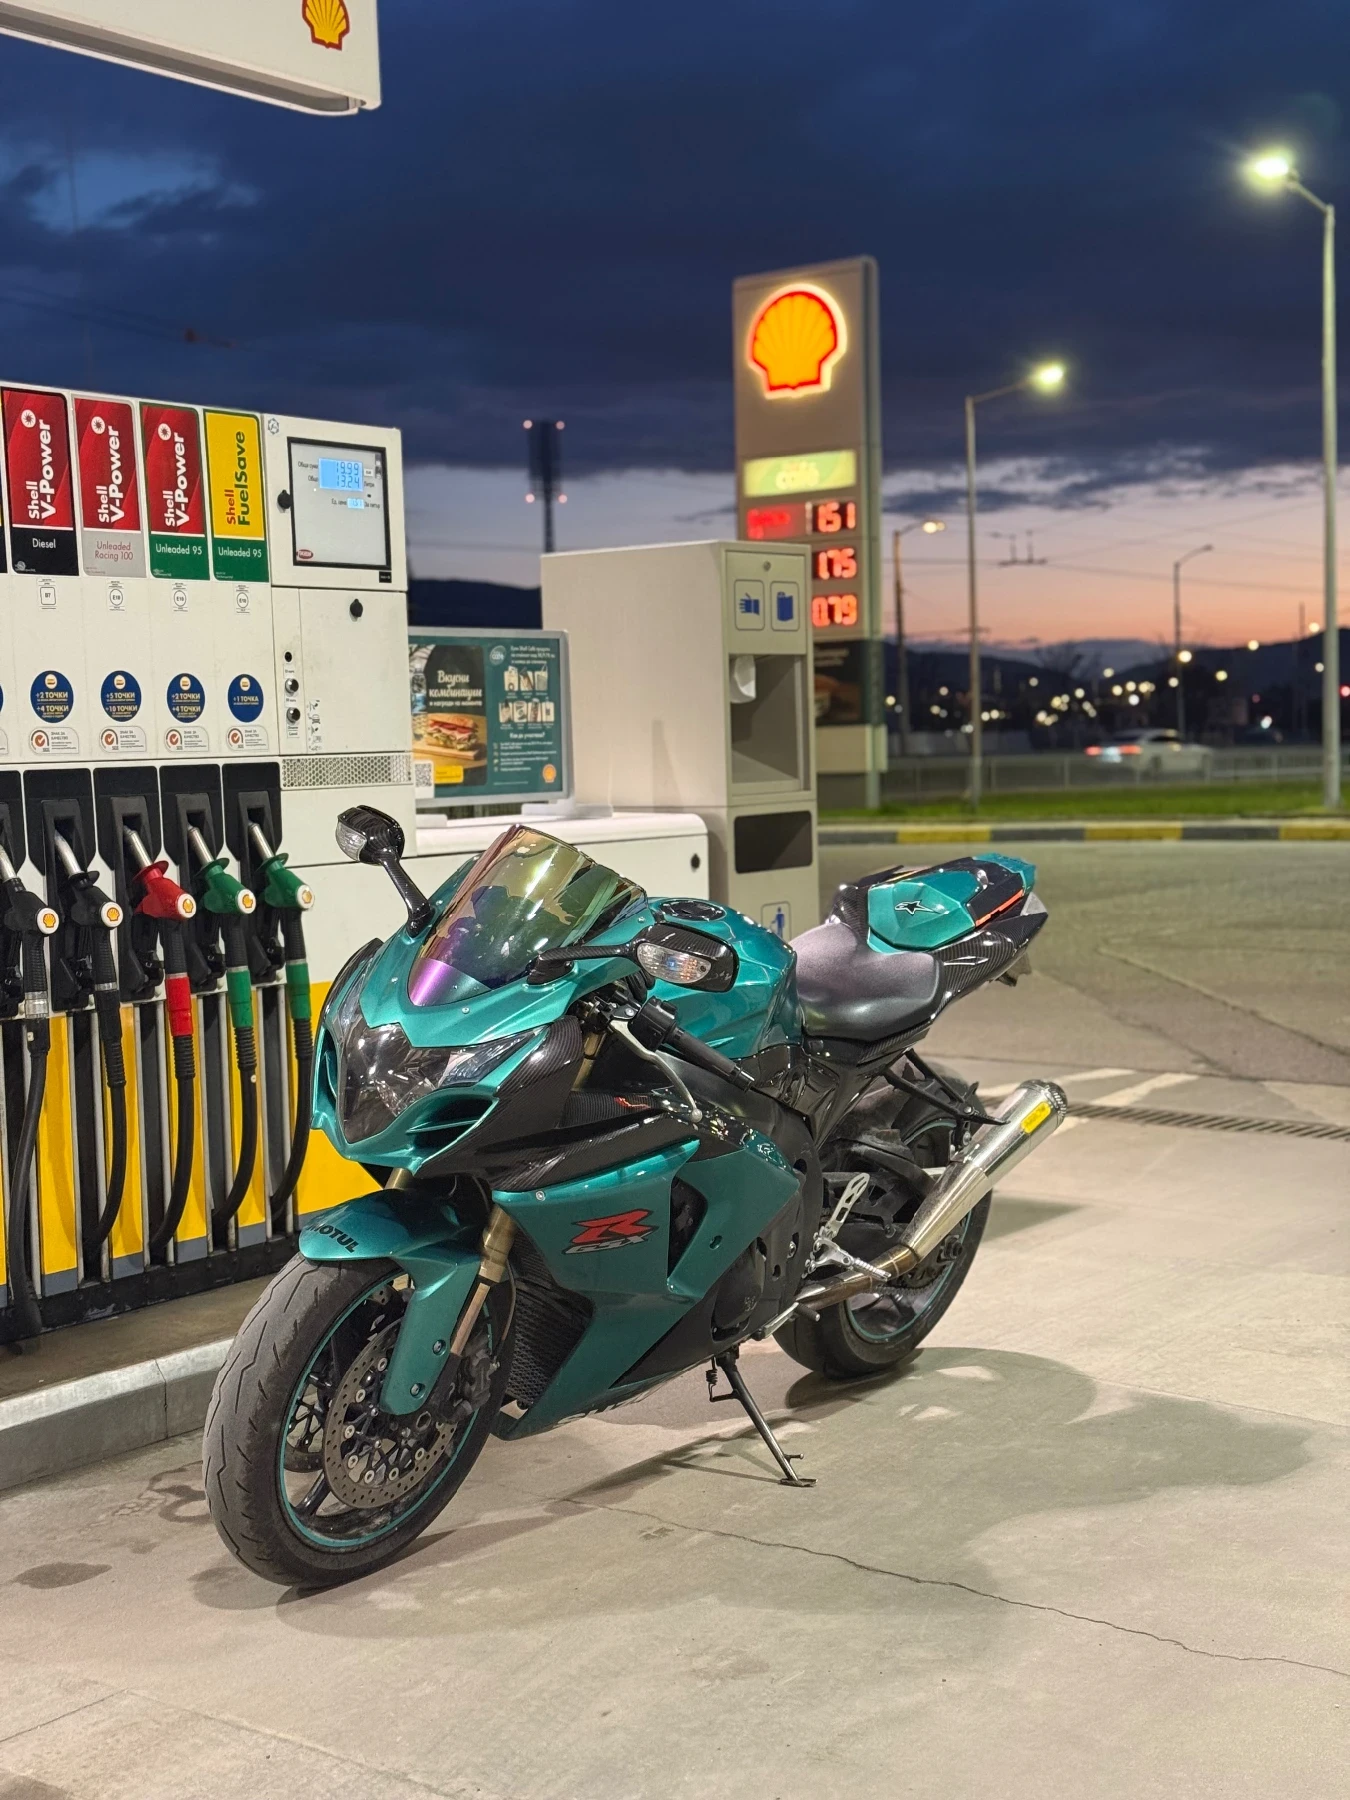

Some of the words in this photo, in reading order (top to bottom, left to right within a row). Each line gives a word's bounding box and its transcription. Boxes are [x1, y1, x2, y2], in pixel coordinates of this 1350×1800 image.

[39, 419, 57, 519] V-Power
[108, 425, 125, 523] V-Power
[174, 432, 190, 527] V-Power
[234, 431, 250, 526] FuelSave
[26, 480, 40, 520] Shell
[96, 485, 110, 523] Shell
[162, 490, 175, 527] Shell
[224, 489, 236, 525] Shell
[32, 538, 56, 549] Diesel
[94, 550, 119, 562] Racing
[120, 551, 134, 560] 100
[96, 541, 131, 551] Unleaded
[155, 543, 190, 555] Unleaded
[192, 546, 202, 556] 95
[218, 546, 250, 558] Unleaded
[252, 549, 262, 558] 95
[429, 684, 482, 700] комбинации
[437, 670, 469, 686] Вкусни
[306, 1223, 360, 1254] MOTUL
